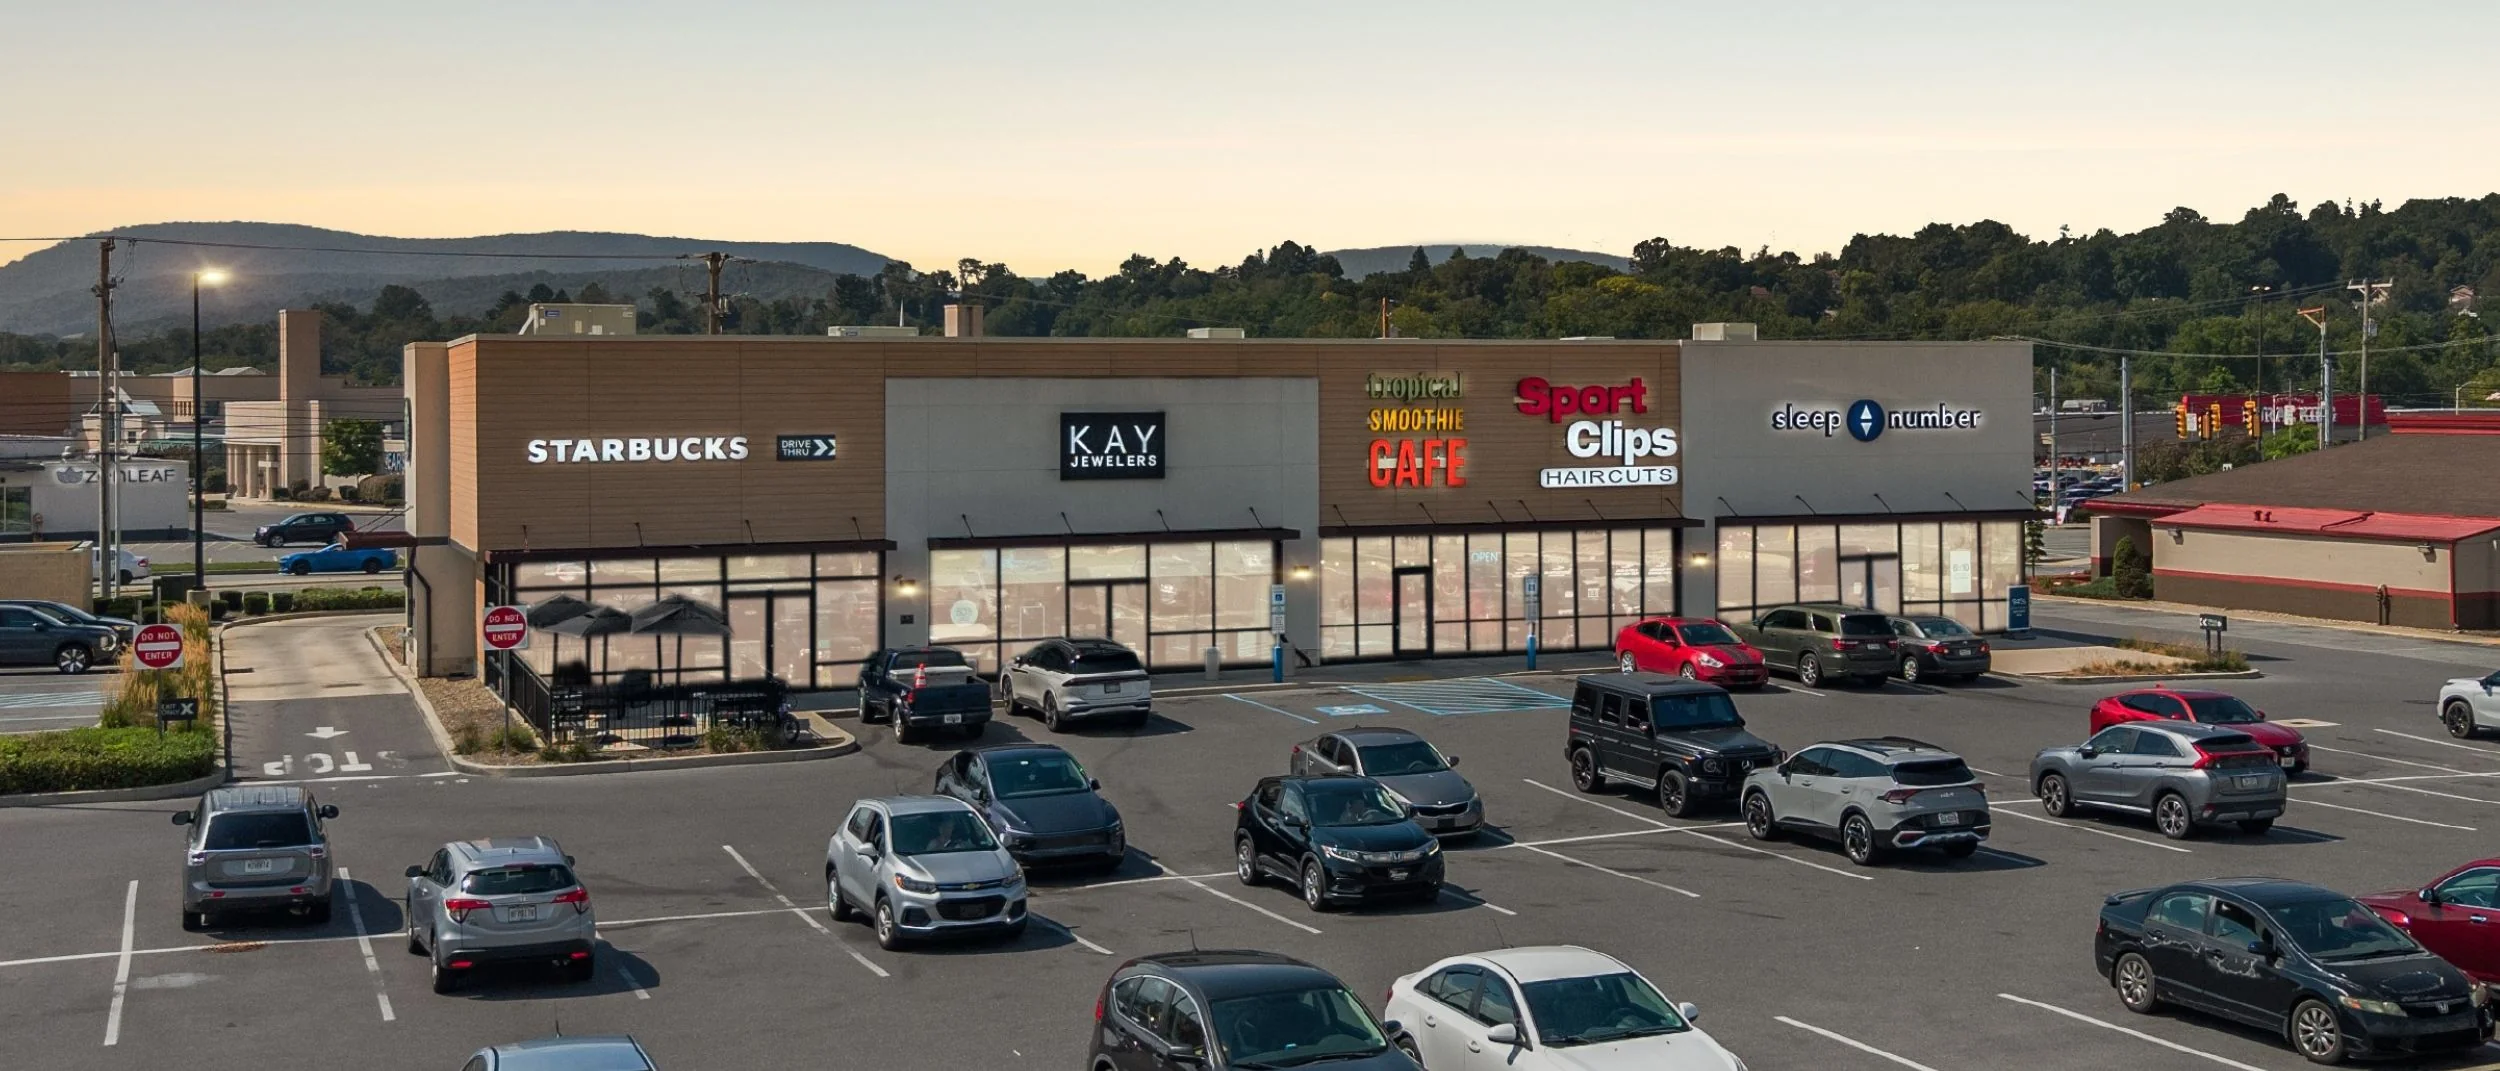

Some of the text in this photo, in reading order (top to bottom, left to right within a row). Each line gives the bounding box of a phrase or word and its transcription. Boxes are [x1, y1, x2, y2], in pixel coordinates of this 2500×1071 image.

[1366, 370, 1464, 403] tropical
[1517, 376, 1648, 424] Sport
[1368, 408, 1465, 432] SMOOTHIE
[1772, 403, 1981, 437] sleep number
[781, 440, 811, 449] DRIVE
[1070, 425, 1157, 454] KAY
[1566, 420, 1679, 466] Clips
[527, 436, 750, 464] STARBUCKS
[781, 448, 809, 456] THRU
[1070, 455, 1157, 468] JEWELERS
[1369, 438, 1468, 488] CAFE
[1546, 468, 1673, 485] HAIRCUTS
[1471, 551, 1498, 563] OPEN
[489, 615, 500, 623] DO
[158, 632, 176, 640] NOT
[145, 652, 172, 660] ENTER
